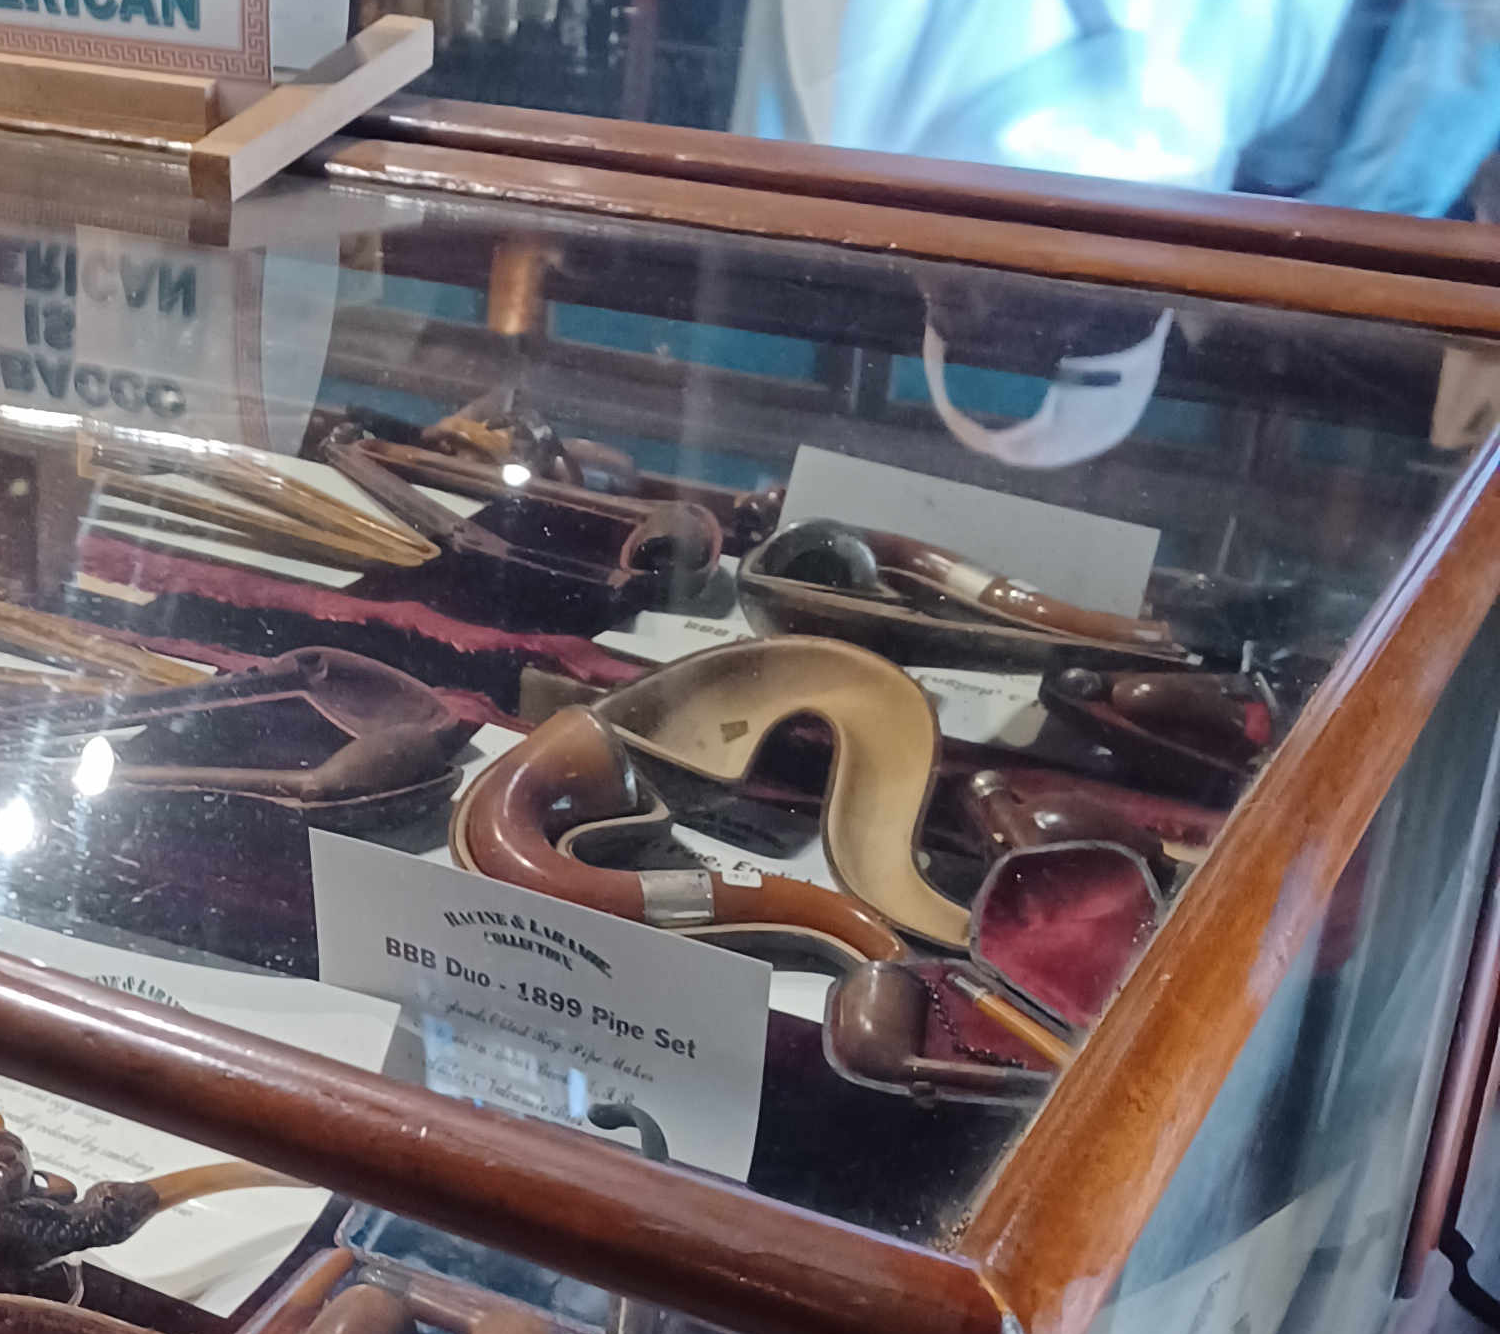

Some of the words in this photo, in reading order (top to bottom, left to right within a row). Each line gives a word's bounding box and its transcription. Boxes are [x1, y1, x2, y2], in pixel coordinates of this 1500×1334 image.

[444, 910, 507, 927] RACINE
[511, 914, 525, 930] &
[530, 919, 613, 979] LARAMIE
[484, 931, 573, 971] COLLECTION
[385, 936, 437, 970] BBB
[446, 956, 491, 989] Duo
[517, 980, 583, 1020] 1899
[592, 1005, 645, 1040] Pipe
[654, 1027, 698, 1061] Set
